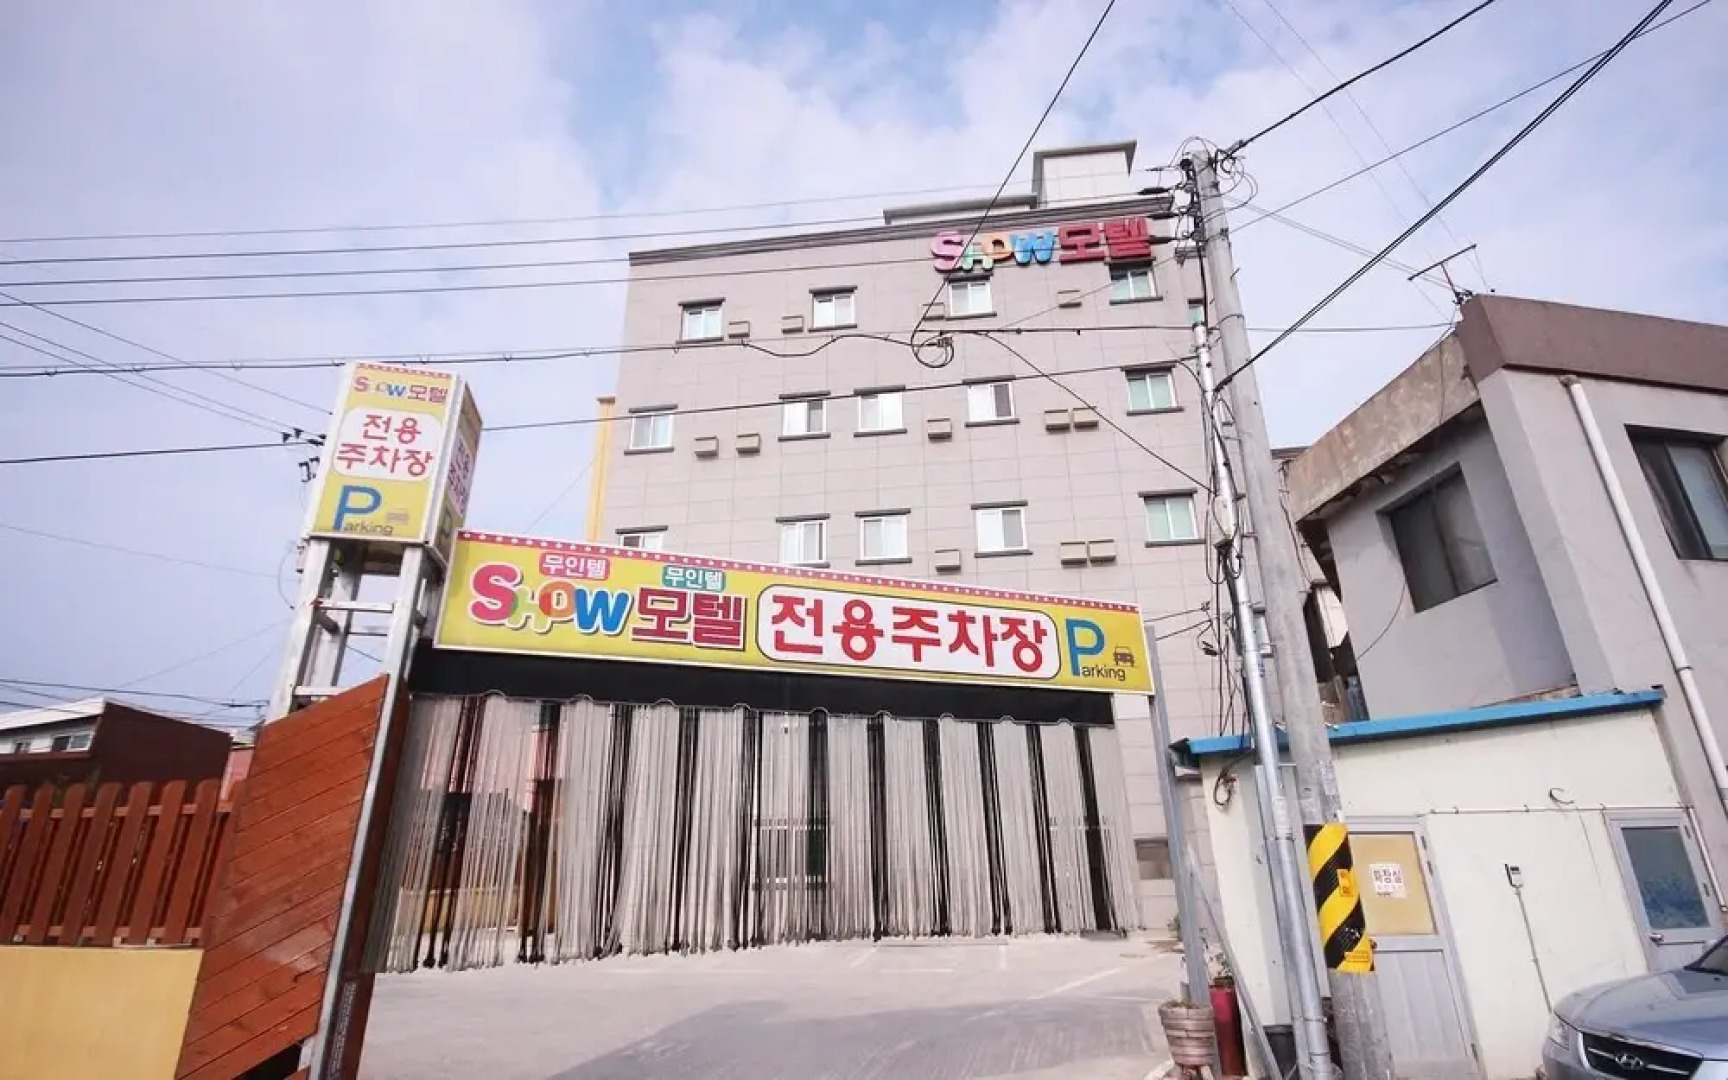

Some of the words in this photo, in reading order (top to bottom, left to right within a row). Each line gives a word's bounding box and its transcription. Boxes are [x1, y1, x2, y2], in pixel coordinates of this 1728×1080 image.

[362, 414, 422, 444] 전용
[336, 443, 434, 478] 주차장
[542, 554, 606, 578] 무인텔
[665, 566, 724, 590] 무인텔
[771, 594, 1048, 673] 전용주차장
[1065, 617, 1126, 682] Parking
